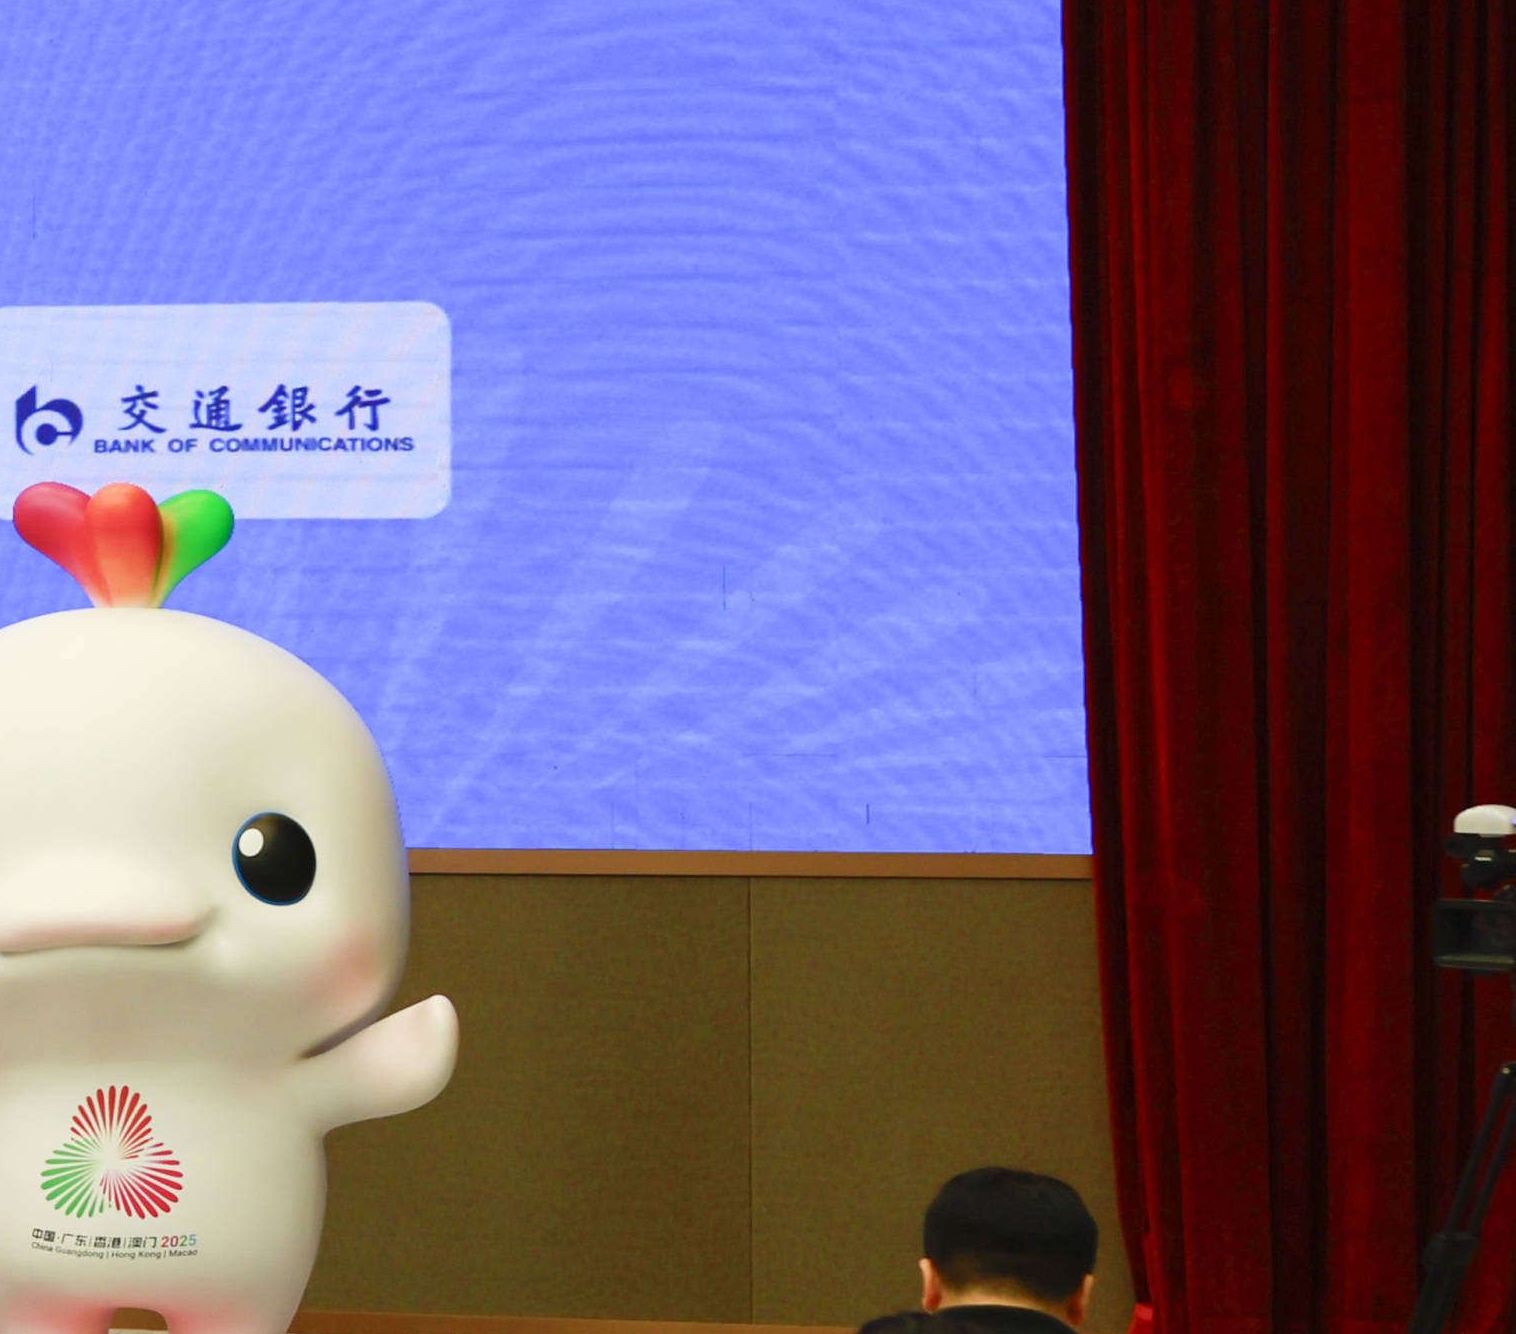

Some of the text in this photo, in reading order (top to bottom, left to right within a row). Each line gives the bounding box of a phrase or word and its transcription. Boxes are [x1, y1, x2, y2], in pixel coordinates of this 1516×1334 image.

[120, 383, 391, 434] 交通銀行
[93, 436, 415, 454] BANK OF COMMUNICATIONS
[161, 1234, 197, 1248] 2025
